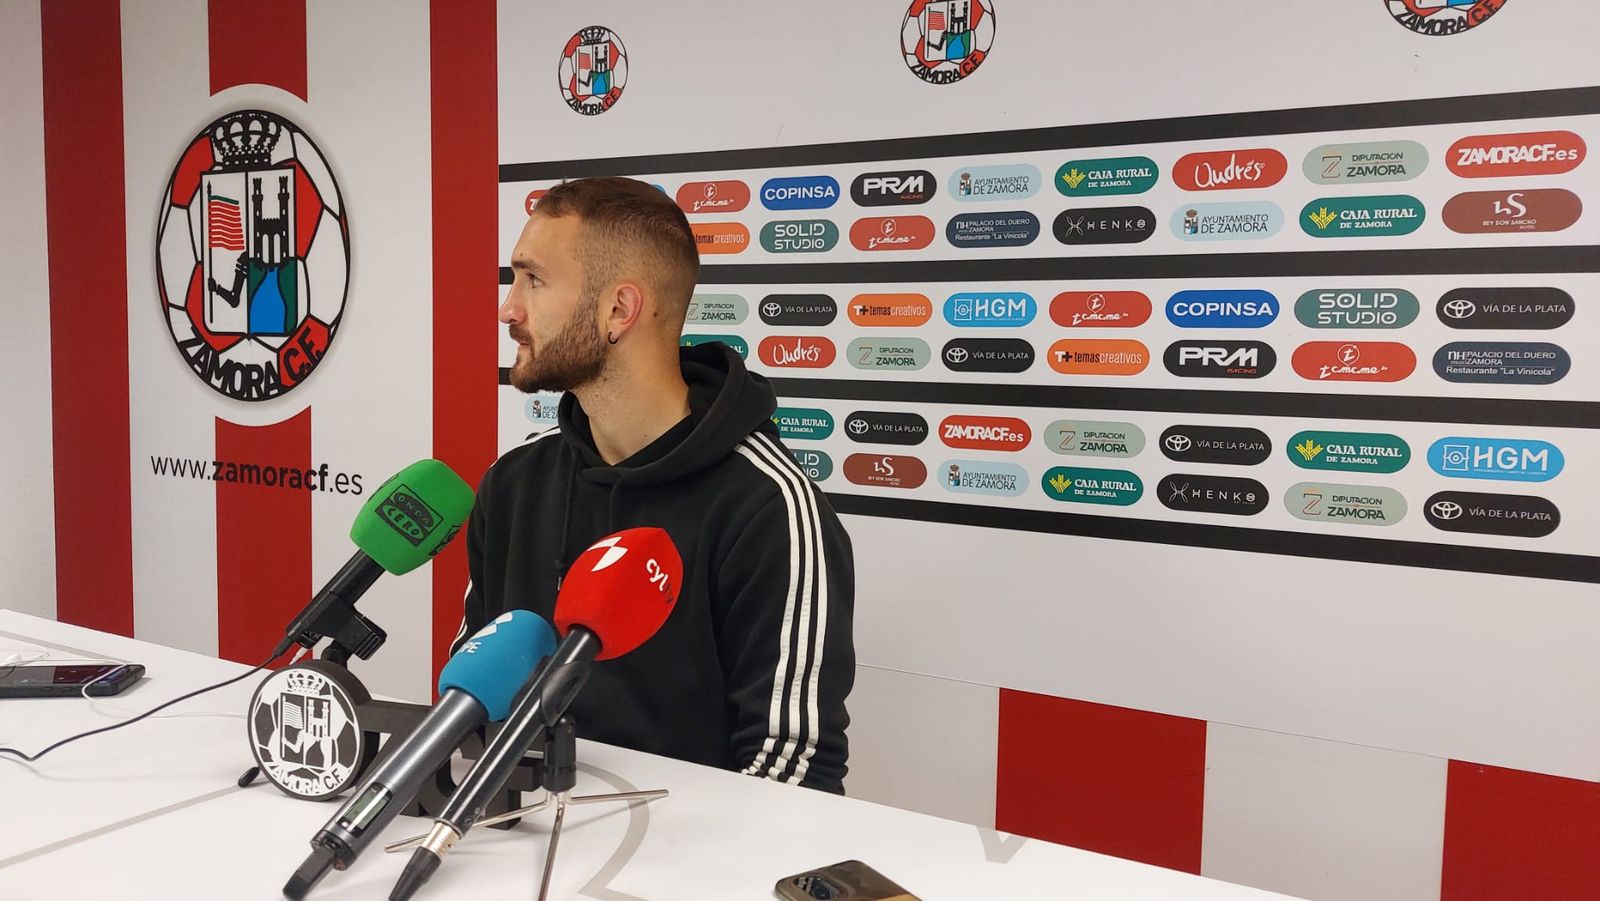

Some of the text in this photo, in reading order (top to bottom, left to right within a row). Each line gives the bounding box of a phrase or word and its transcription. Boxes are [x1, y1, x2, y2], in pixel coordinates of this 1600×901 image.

[1394, 12, 1468, 35] ZAMORA
[911, 64, 961, 83] ZAMORA
[567, 96, 604, 115] ZAMORA
[1457, 143, 1578, 166] ZAMORACF.es
[1088, 168, 1151, 180] CAJA RURAL
[1347, 165, 1406, 178] ZAMORA
[864, 176, 923, 195] PRM
[974, 176, 1029, 187] AYUNTAMIENTO
[765, 186, 835, 200] COPINSA
[973, 182, 1028, 195] DE ZAMORA
[1202, 214, 1269, 224] AYUNTAMIENTO
[1340, 208, 1417, 220] CAJA RURAL
[775, 223, 825, 237] SOLID
[1201, 222, 1268, 233] DE ZAMORA
[1356, 220, 1392, 229] ZAMORA
[775, 239, 825, 250] STUDIO
[1319, 293, 1398, 308] SOLID
[975, 299, 1026, 317] HGM
[1173, 302, 1273, 316] COPINSA
[1483, 302, 1566, 313] VÍA DE LA PLATA
[1318, 311, 1396, 324] STUDIO
[876, 357, 915, 366] ZAMORA
[973, 351, 984, 359] VÍA
[1179, 347, 1257, 367] PRM
[180, 327, 281, 398] ZAMORA
[802, 419, 828, 427] RURAL
[872, 423, 883, 431] VÍA
[945, 424, 1023, 442] ZAMORACF.es
[1080, 442, 1128, 453] ZAMORA
[1197, 440, 1211, 448] VÍA
[1213, 441, 1224, 449] DE
[1327, 444, 1402, 458] CAJA RURAL
[1474, 446, 1548, 471] HGM
[151, 456, 362, 495] www.zamoracf.es
[962, 472, 1016, 482] AYUNTAMIENTO
[962, 479, 1016, 490] DE ZAMORA
[1075, 479, 1136, 491] CAJA RURAL
[398, 495, 429, 523] ONDA
[1328, 507, 1385, 520] ZAMORA
[1469, 508, 1551, 521] VÍA DE LA PLATA
[388, 508, 420, 535] CERO
[262, 762, 320, 795] ZAMORA
